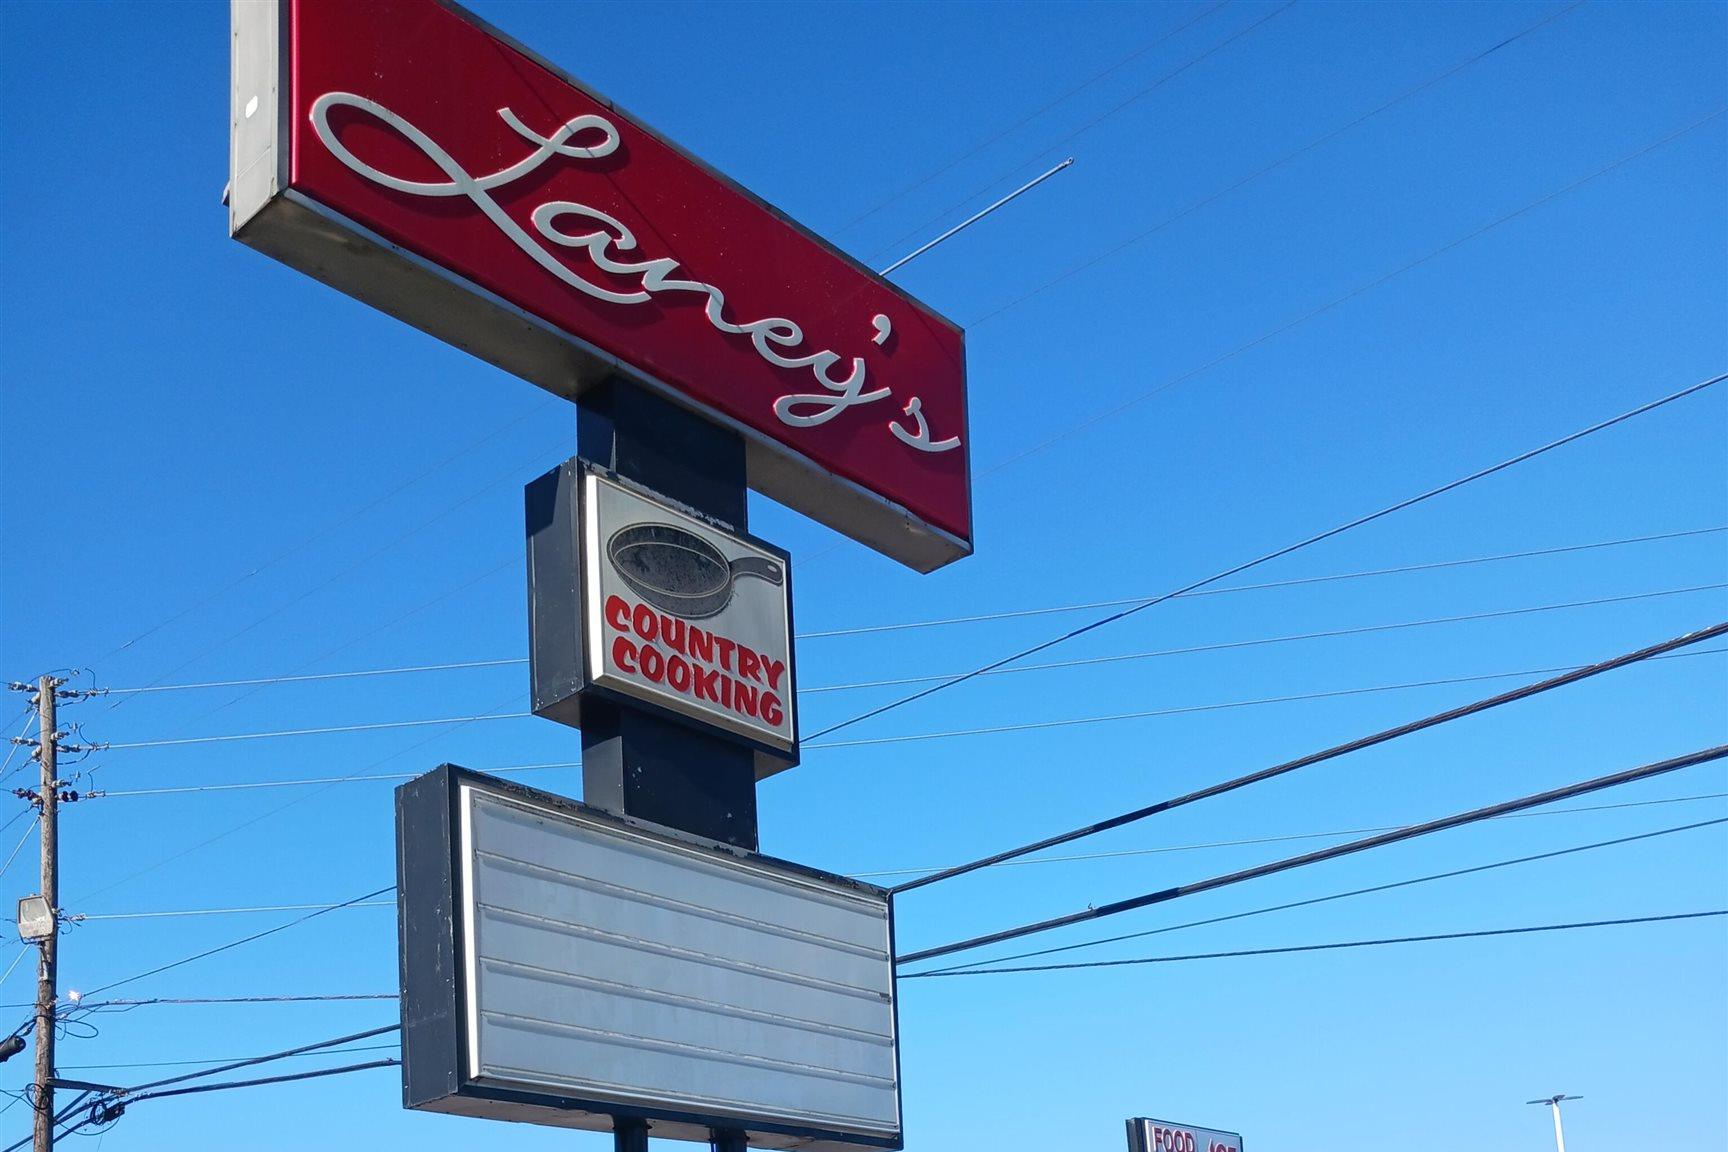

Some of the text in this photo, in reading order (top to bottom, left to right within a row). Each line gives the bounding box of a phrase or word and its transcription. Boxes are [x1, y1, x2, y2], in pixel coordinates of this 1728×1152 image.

[309, 92, 961, 453] Laney's
[605, 594, 785, 692] COUNTRY
[612, 635, 783, 727] COOKING
